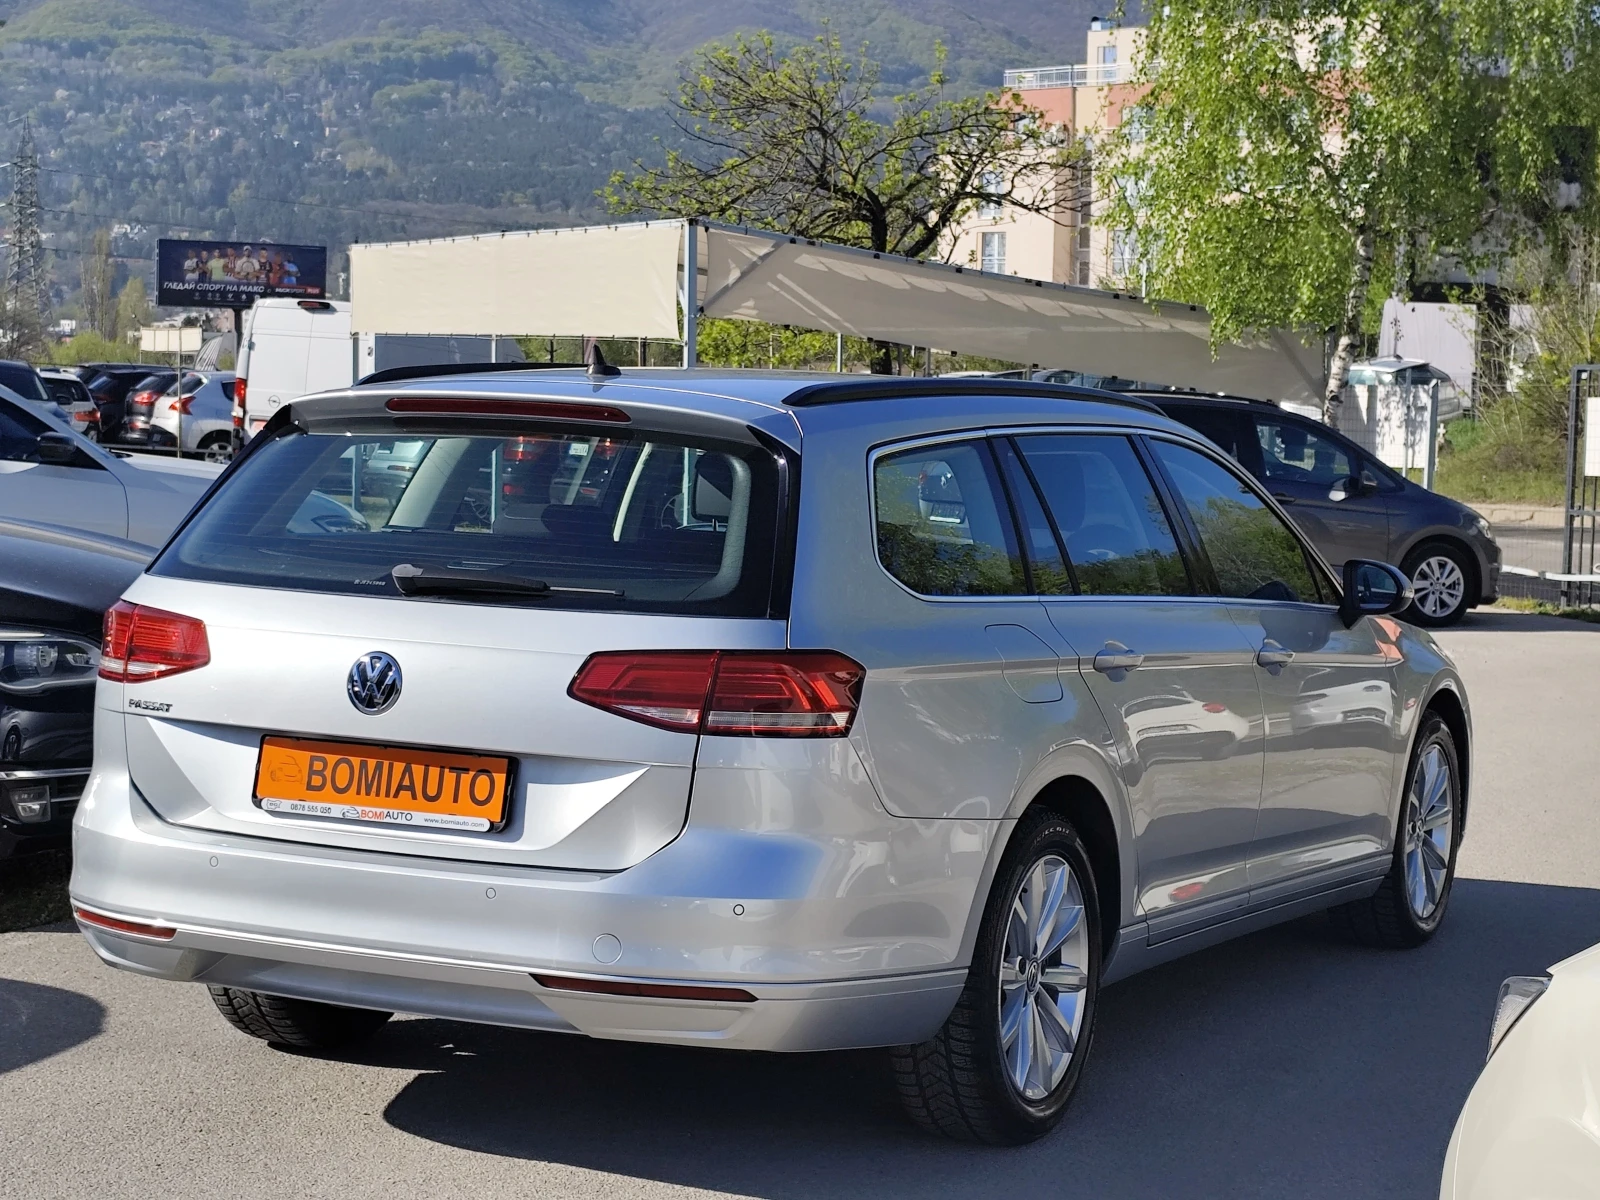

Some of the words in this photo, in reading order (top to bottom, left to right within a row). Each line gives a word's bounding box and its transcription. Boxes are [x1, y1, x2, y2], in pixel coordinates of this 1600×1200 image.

[163, 281, 196, 290] ГЛЕДАЙ
[196, 283, 226, 291] СПОРТ
[226, 284, 239, 292] НА
[238, 284, 265, 293] МАКС
[128, 698, 173, 713] PASSAT
[306, 754, 496, 807] BOMIAUTO
[290, 803, 306, 812] 0878
[307, 804, 318, 812] 555
[360, 810, 413, 822] BOMIAUTO
[424, 816, 485, 828] www.bomiauto.com
